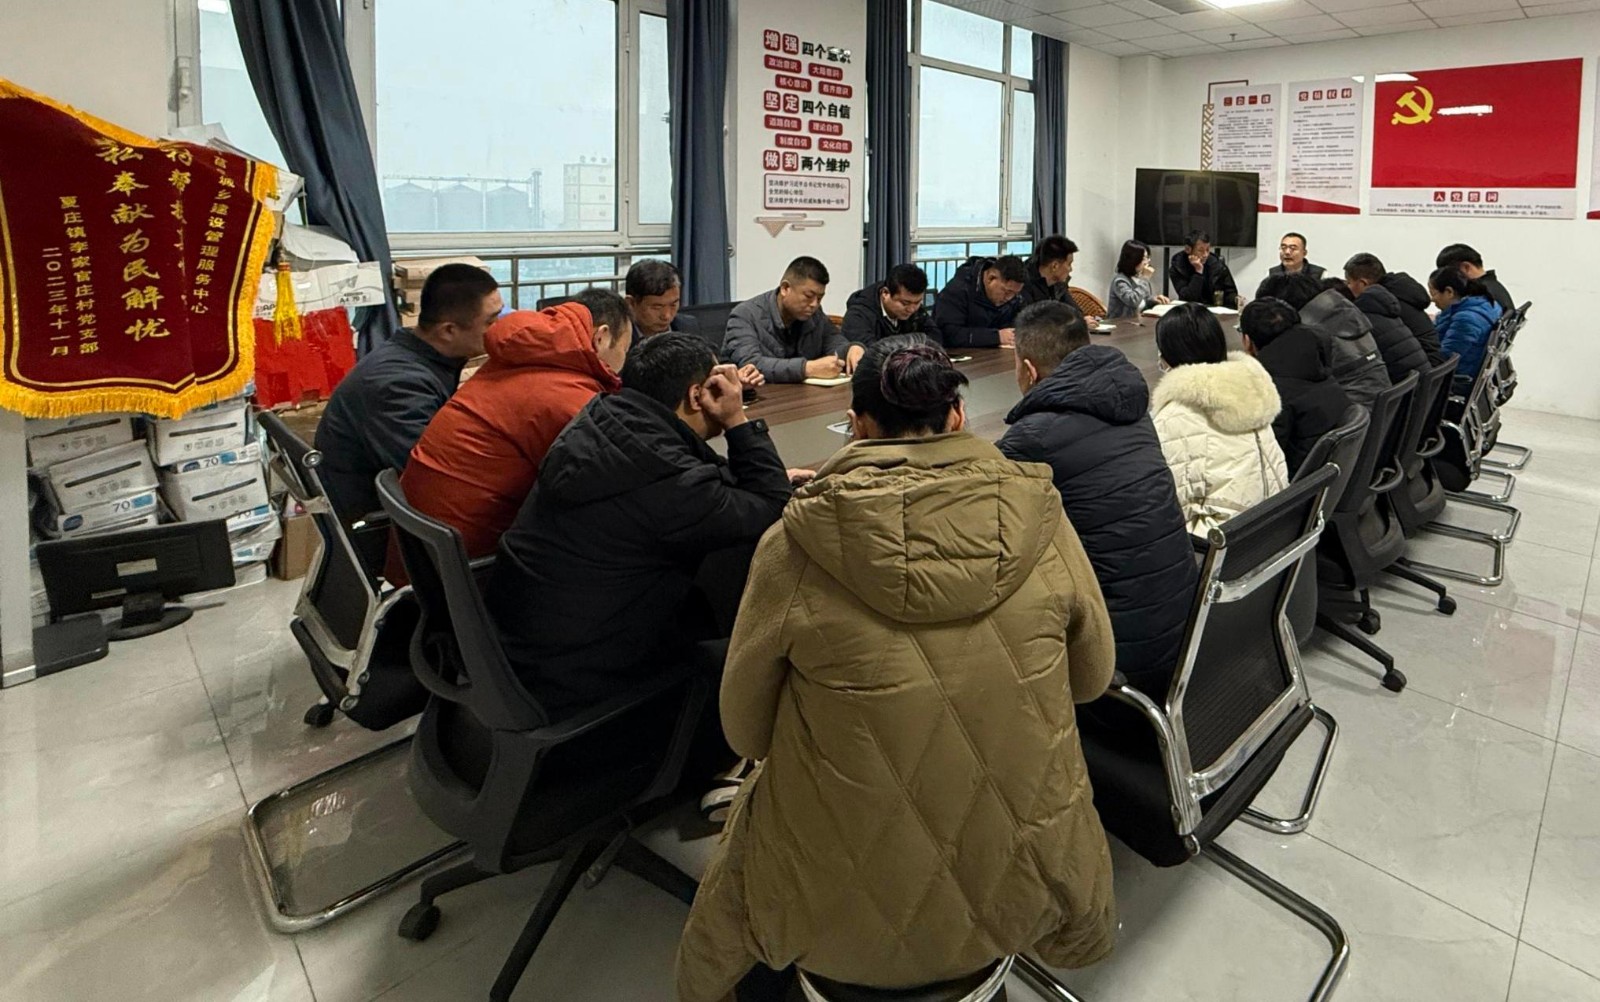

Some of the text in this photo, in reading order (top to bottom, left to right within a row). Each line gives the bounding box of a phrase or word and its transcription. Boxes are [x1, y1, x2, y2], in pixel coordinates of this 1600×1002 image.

[59, 195, 99, 355] 夏庄镇李家官庄村党支部
[204, 456, 219, 468] 70
[113, 500, 131, 512] 70
